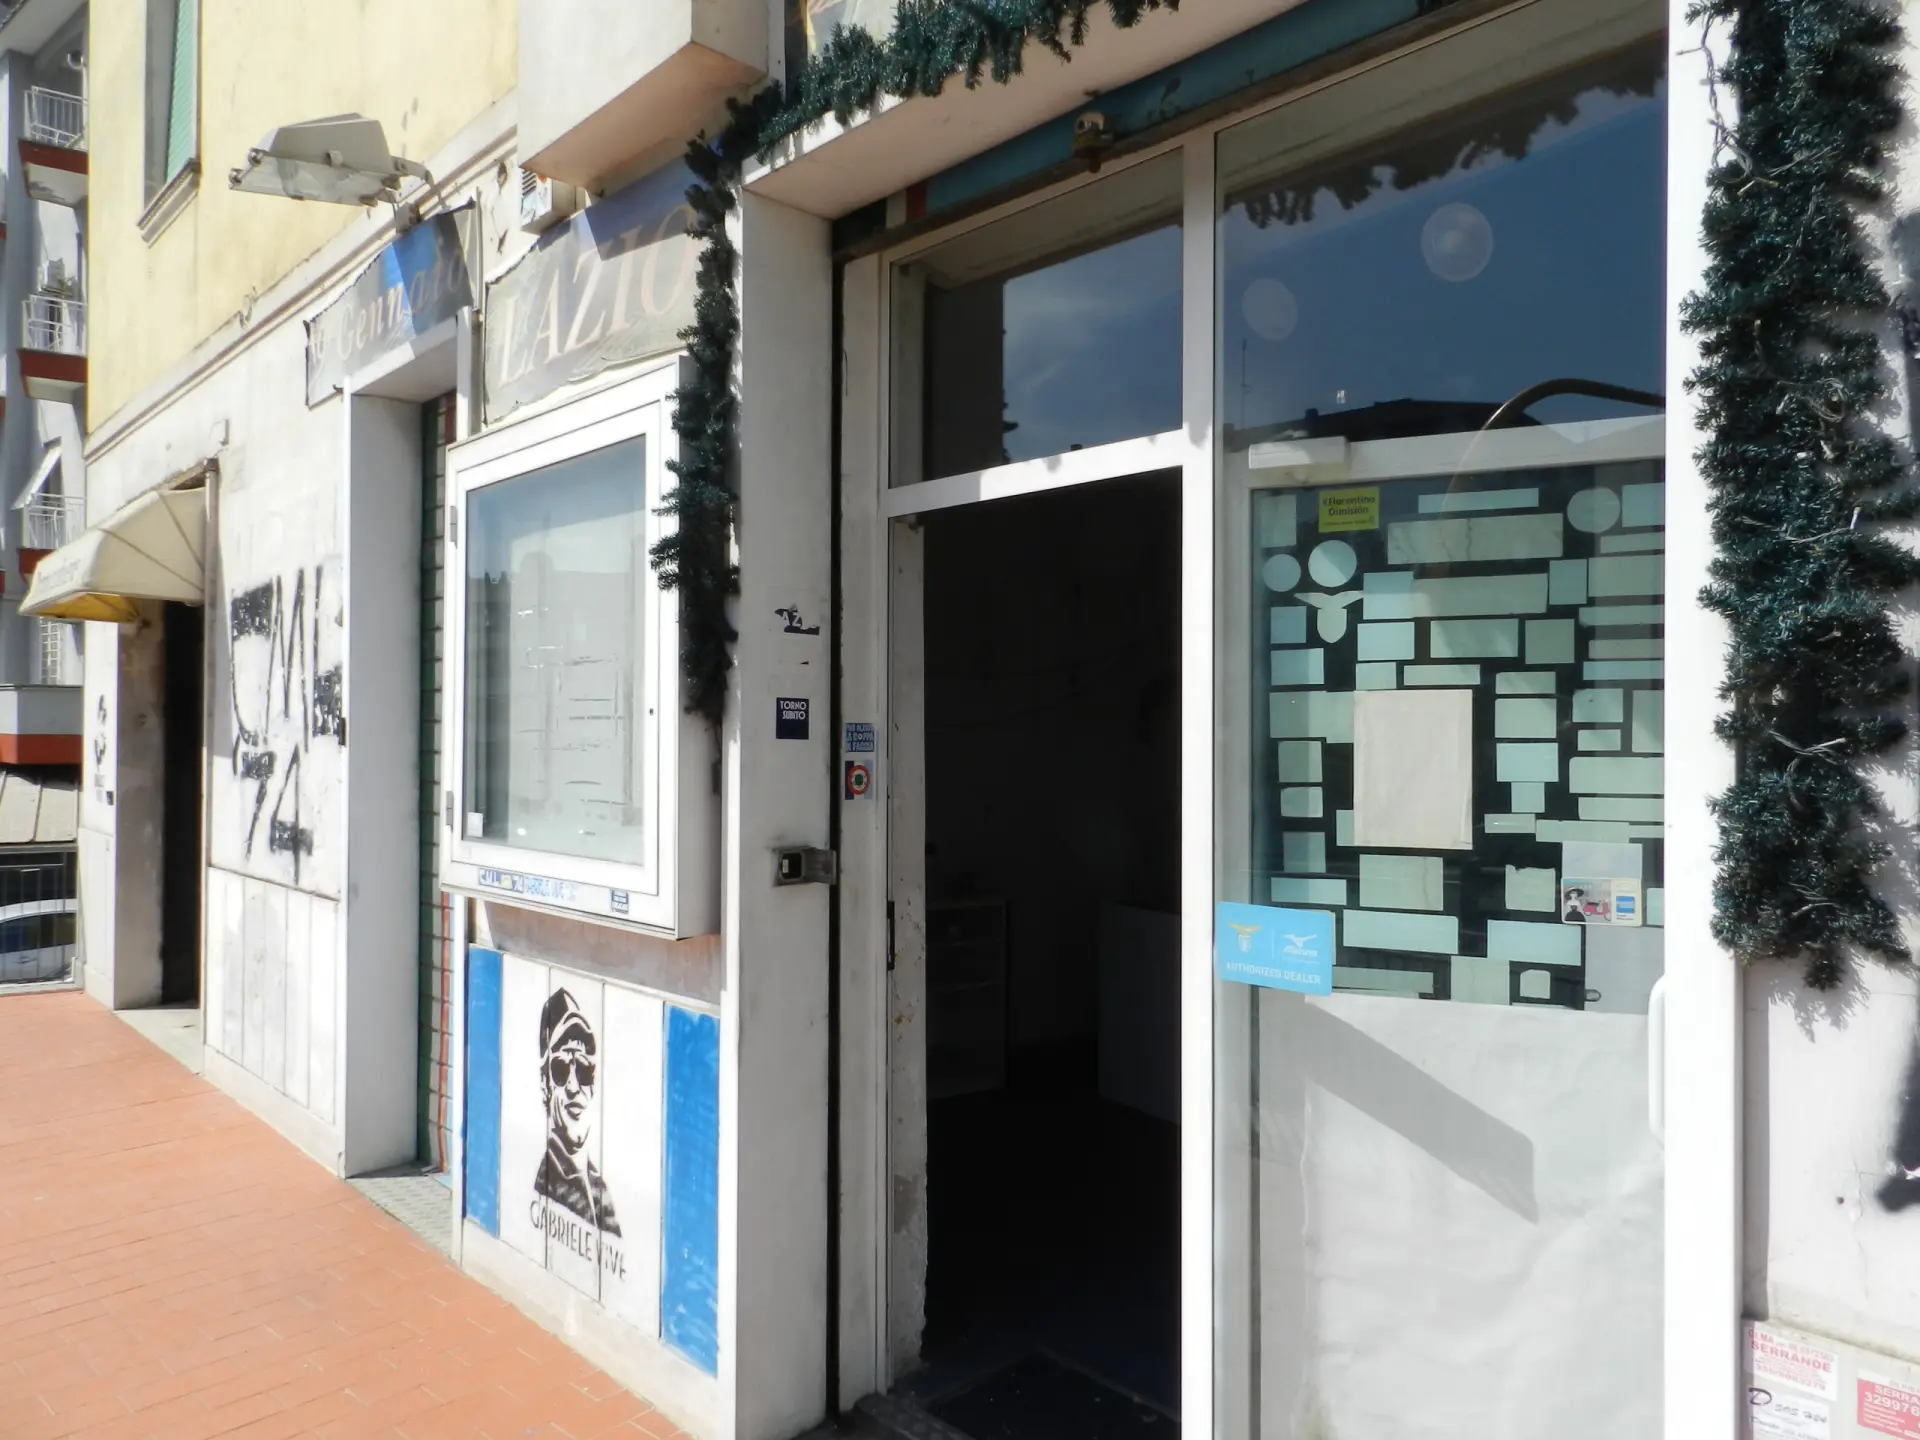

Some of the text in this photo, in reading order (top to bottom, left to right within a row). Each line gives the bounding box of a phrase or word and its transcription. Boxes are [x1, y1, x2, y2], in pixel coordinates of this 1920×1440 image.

[498, 205, 696, 391] LAZIO
[780, 701, 807, 710] TORNO
[1226, 961, 1282, 979] AUTHORIZED
[1284, 971, 1322, 985] DEALER
[530, 1200, 592, 1261] GABRIELE
[1751, 1340, 1831, 1373] SERRANDE
